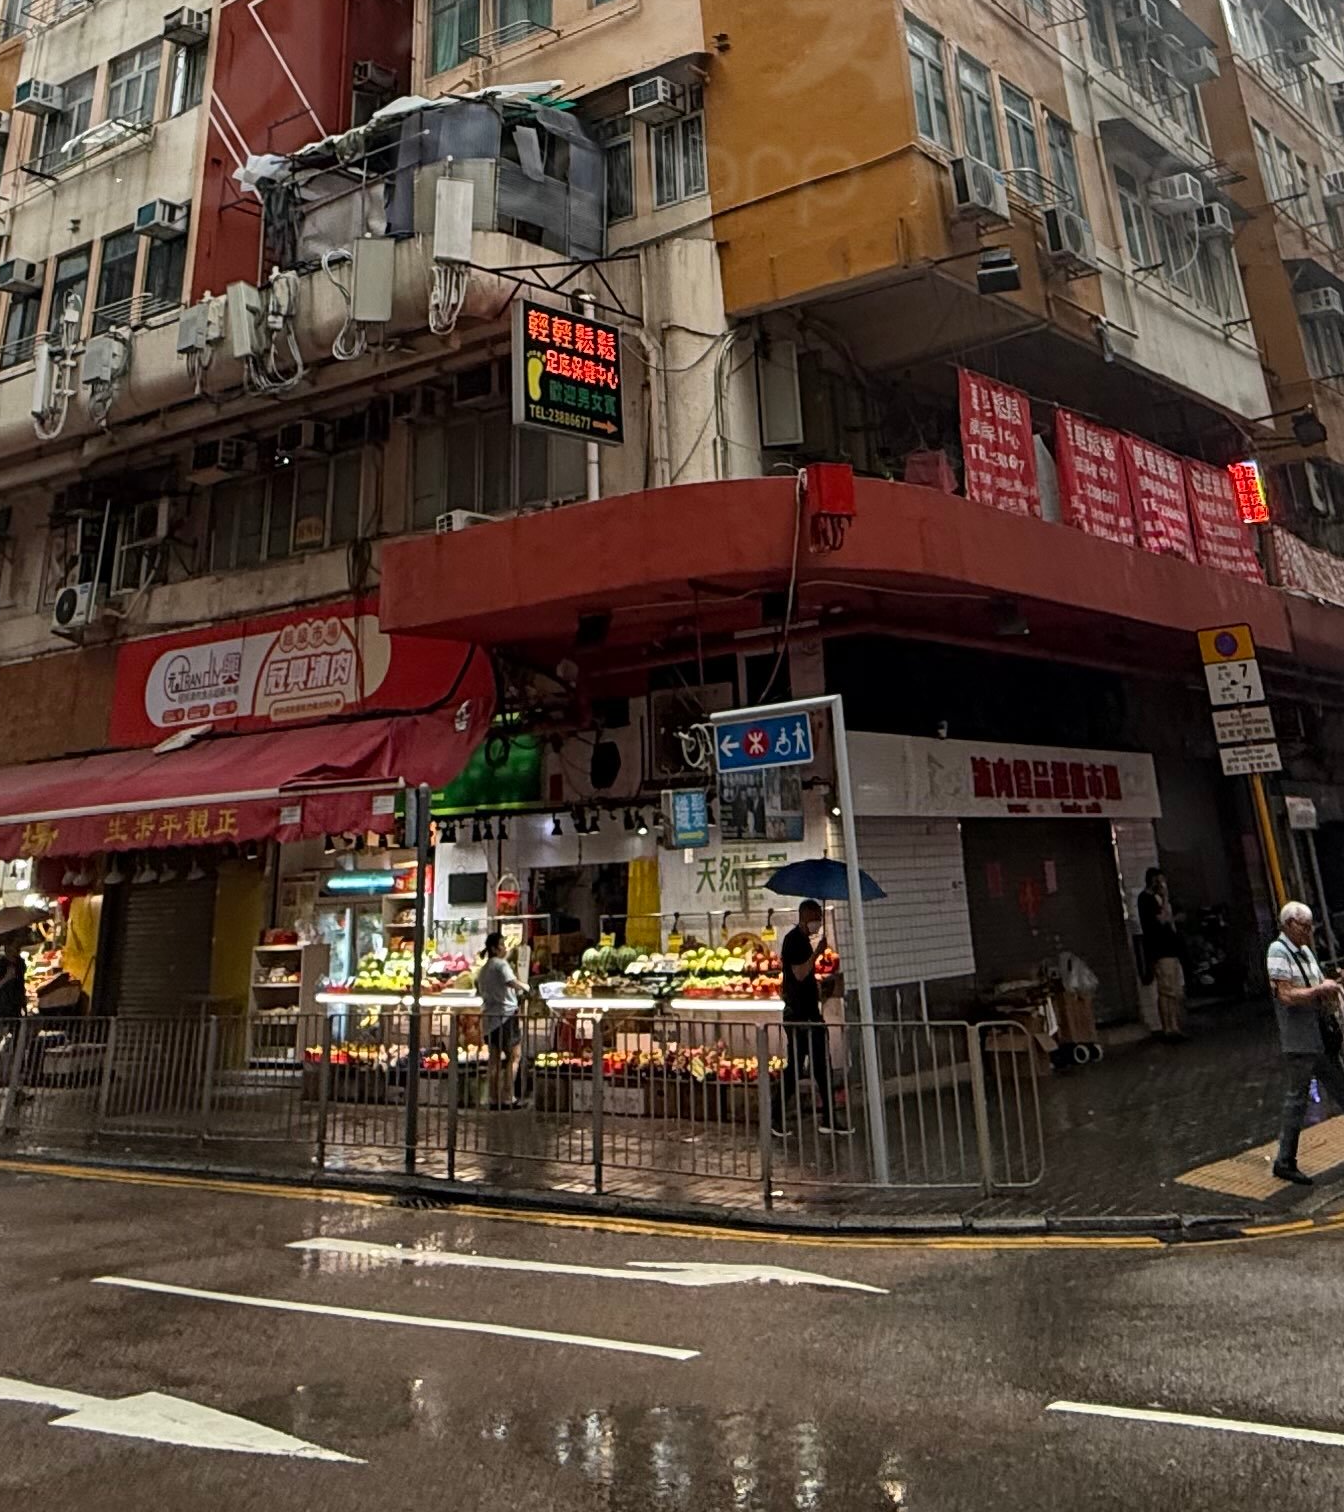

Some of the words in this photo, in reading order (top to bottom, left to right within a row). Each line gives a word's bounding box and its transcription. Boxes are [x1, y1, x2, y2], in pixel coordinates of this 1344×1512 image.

[527, 309, 617, 362] 輕輕鬆鬆
[545, 349, 619, 390] 足底保健中心
